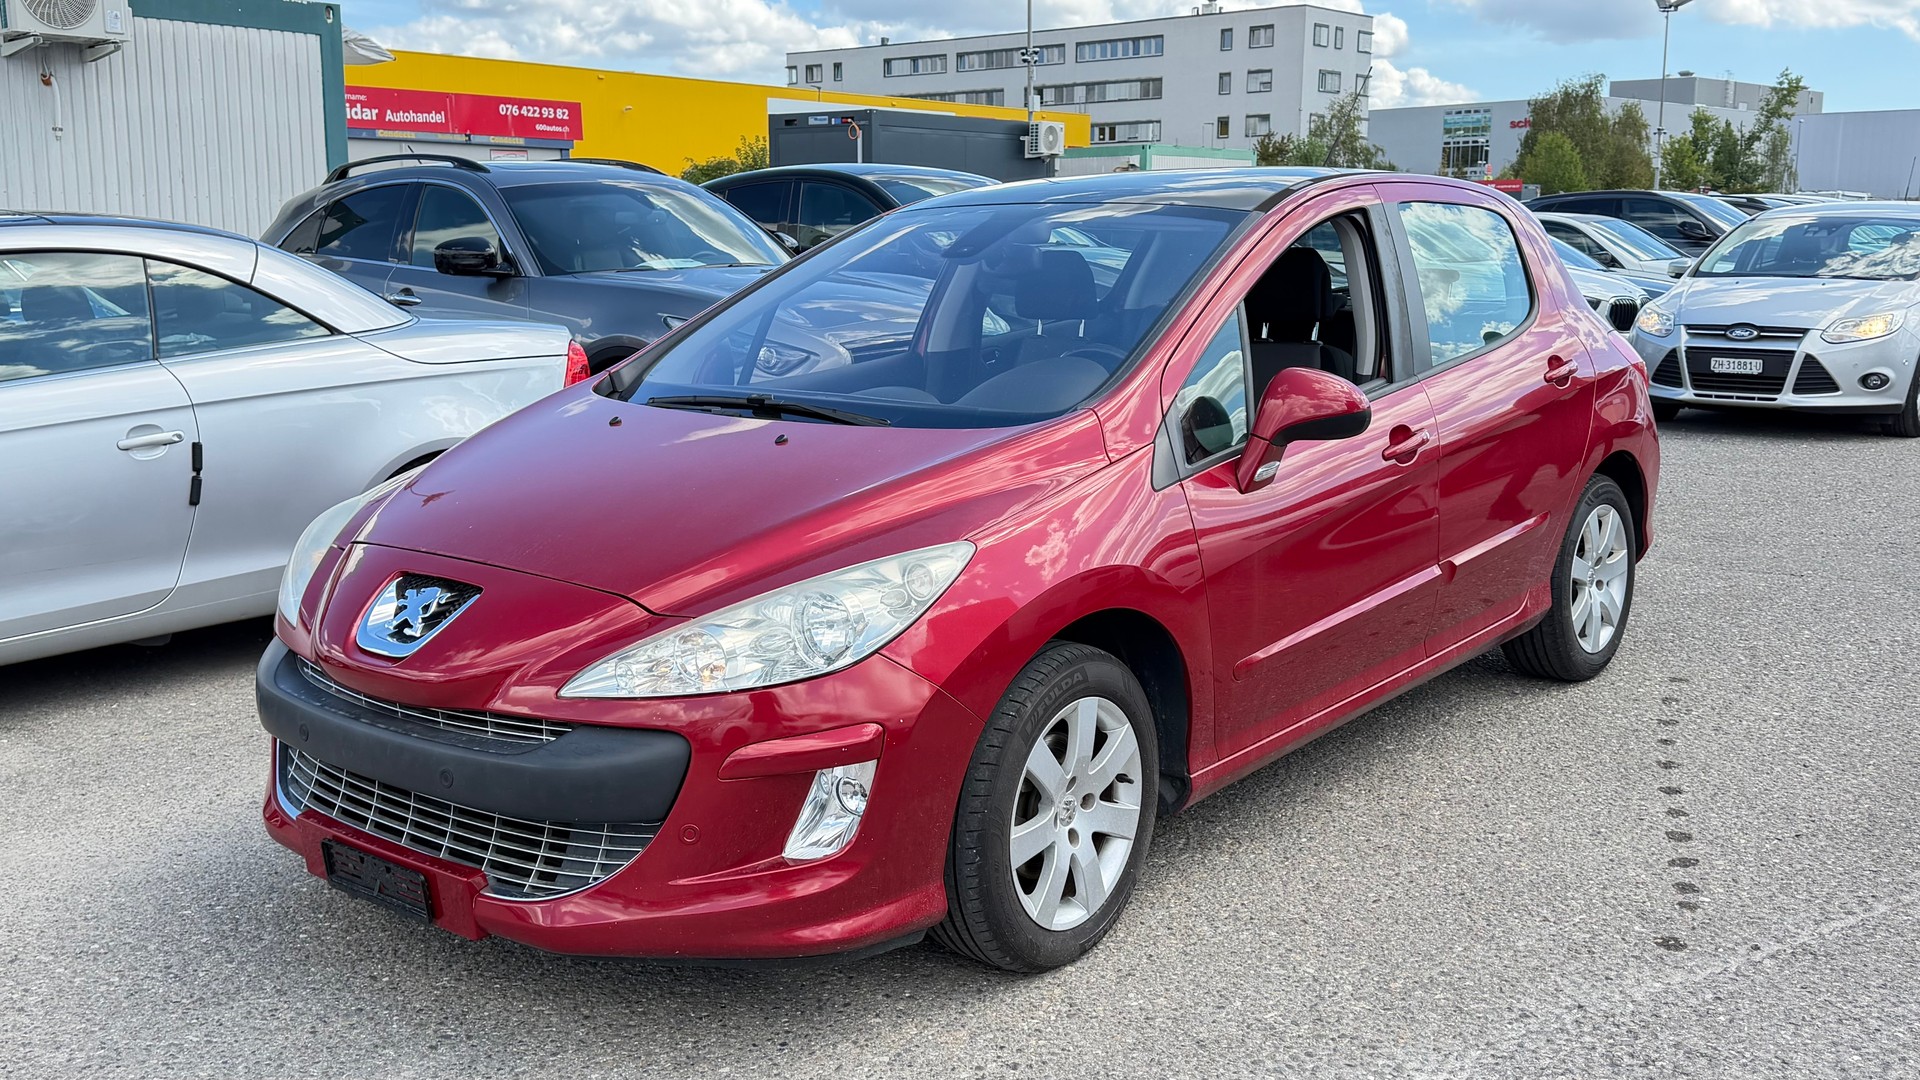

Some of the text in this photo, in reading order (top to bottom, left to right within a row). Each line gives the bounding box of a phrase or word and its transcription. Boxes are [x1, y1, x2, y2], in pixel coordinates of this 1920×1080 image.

[346, 103, 445, 123] idar Autohandel
[499, 104, 569, 119] 076 422 93 82
[535, 123, 569, 132] 600autos.ch
[1037, 672, 1084, 713] FULDA
